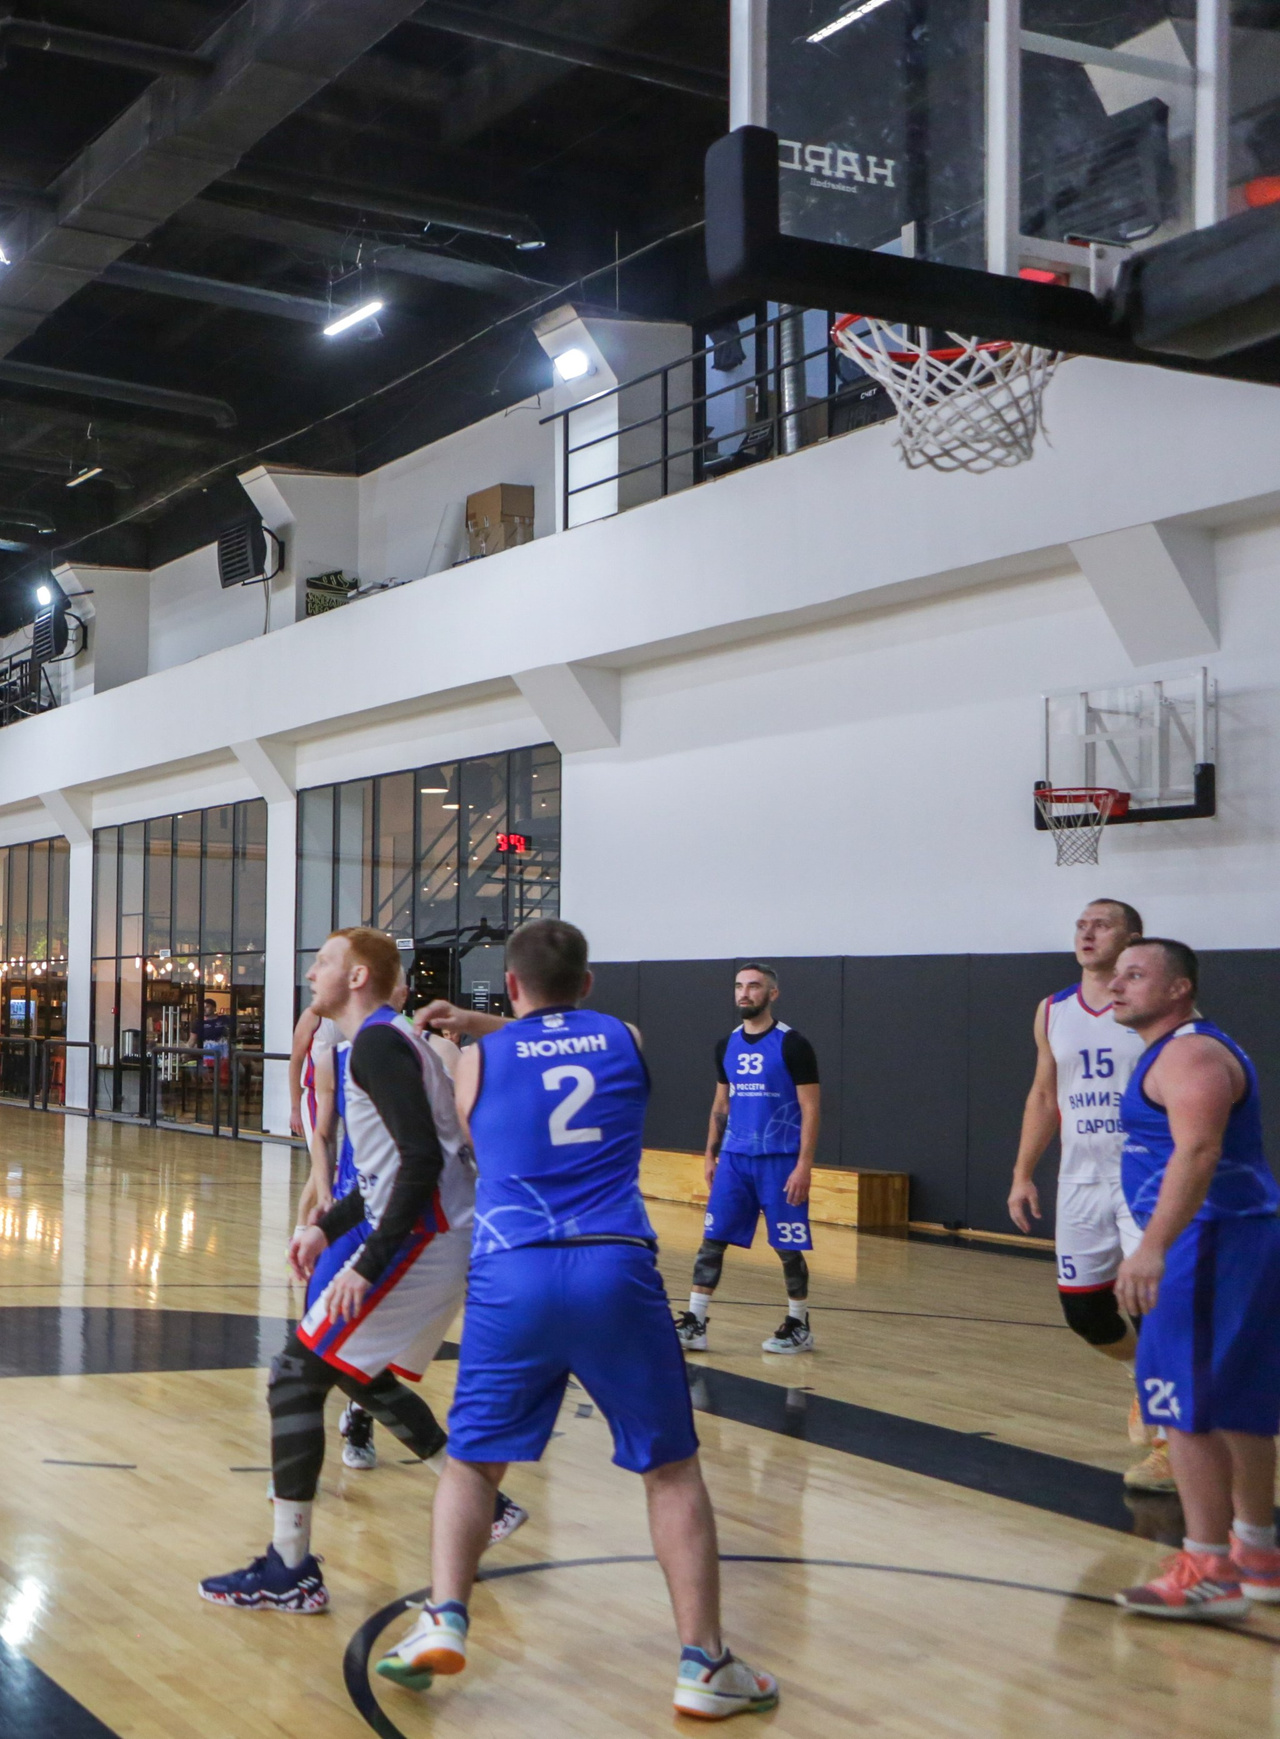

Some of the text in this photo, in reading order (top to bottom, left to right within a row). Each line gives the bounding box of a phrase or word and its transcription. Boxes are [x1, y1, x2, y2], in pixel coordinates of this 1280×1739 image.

[515, 1033, 608, 1058] ЗЮКИН
[736, 1052, 764, 1075] 33
[1078, 1047, 1115, 1079] 15
[541, 1064, 603, 1146] 2
[776, 1222, 808, 1243] 33
